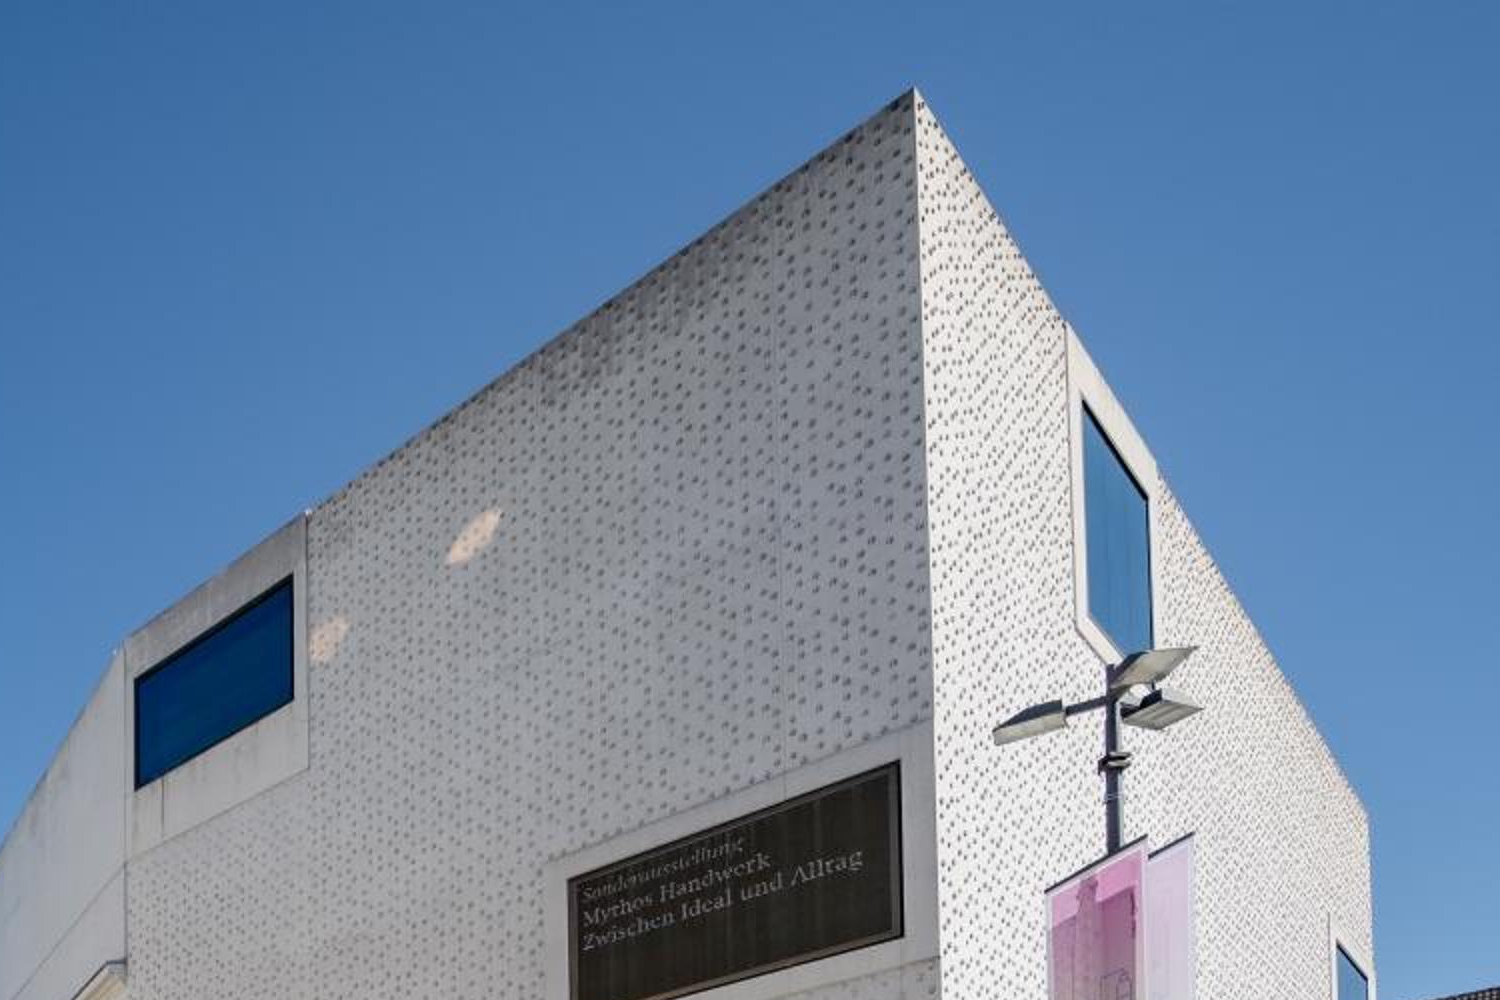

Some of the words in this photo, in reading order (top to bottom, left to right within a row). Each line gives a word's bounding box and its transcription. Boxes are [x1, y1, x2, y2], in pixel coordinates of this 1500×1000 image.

[583, 894, 653, 928] Mythos
[660, 852, 771, 902] Handwerk
[583, 911, 674, 951] Zwischen
[681, 887, 732, 920] Ideal
[740, 870, 782, 901] und
[791, 850, 863, 887] Alltag
